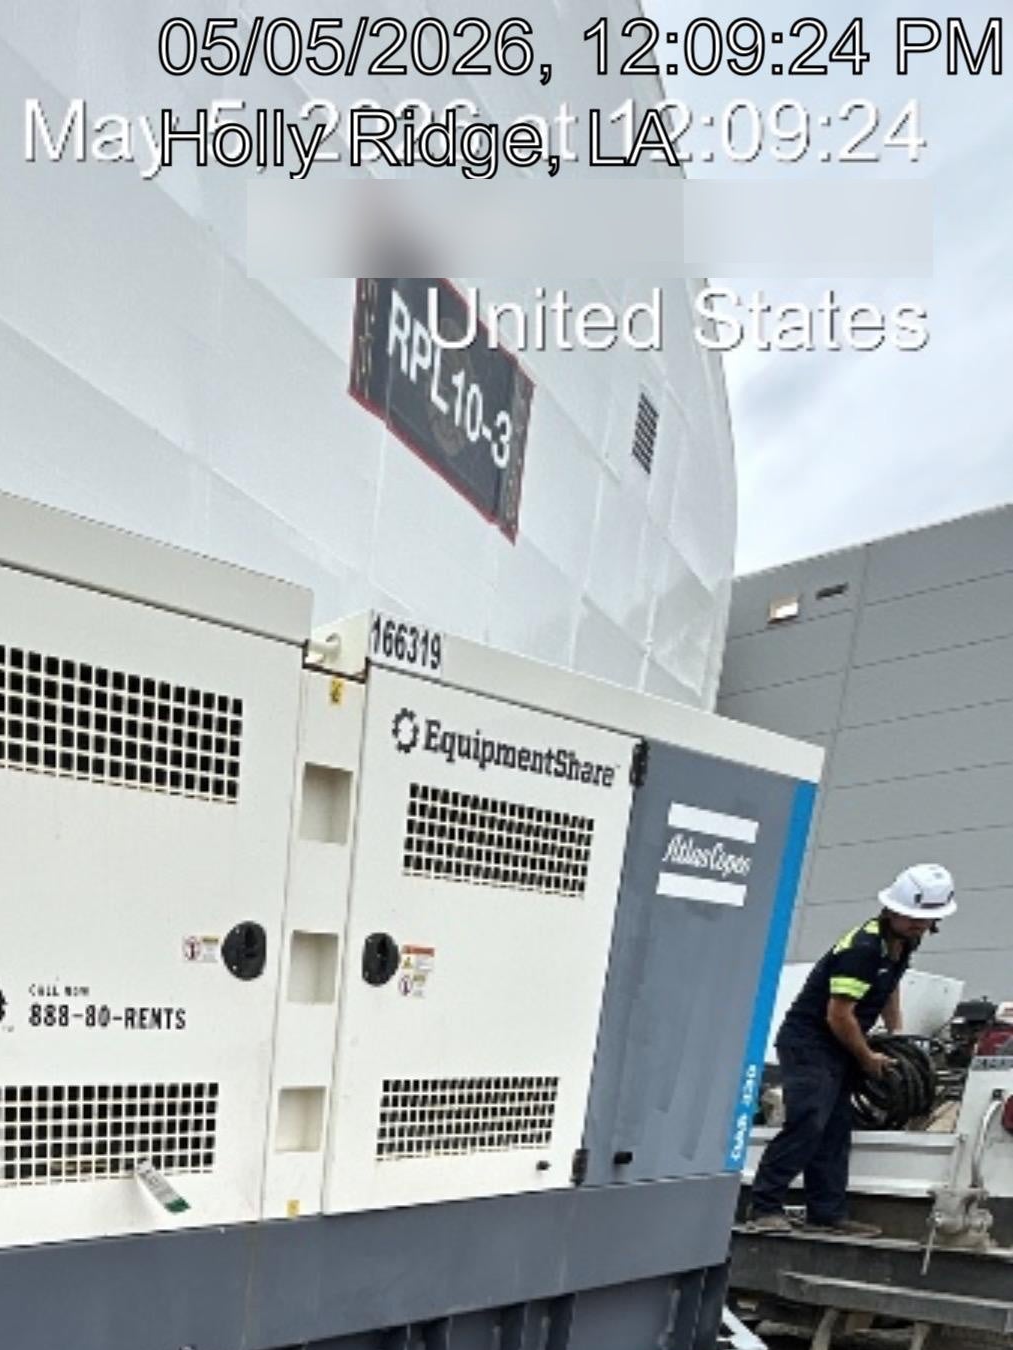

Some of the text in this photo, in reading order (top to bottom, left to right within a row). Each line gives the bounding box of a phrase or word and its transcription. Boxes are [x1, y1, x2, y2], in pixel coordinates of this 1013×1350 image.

[388, 288, 514, 470] RPL10-3
[370, 613, 442, 670] 166319
[422, 717, 617, 789] EquipmentShare
[28, 1003, 187, 1031] 888-80-RENTS
